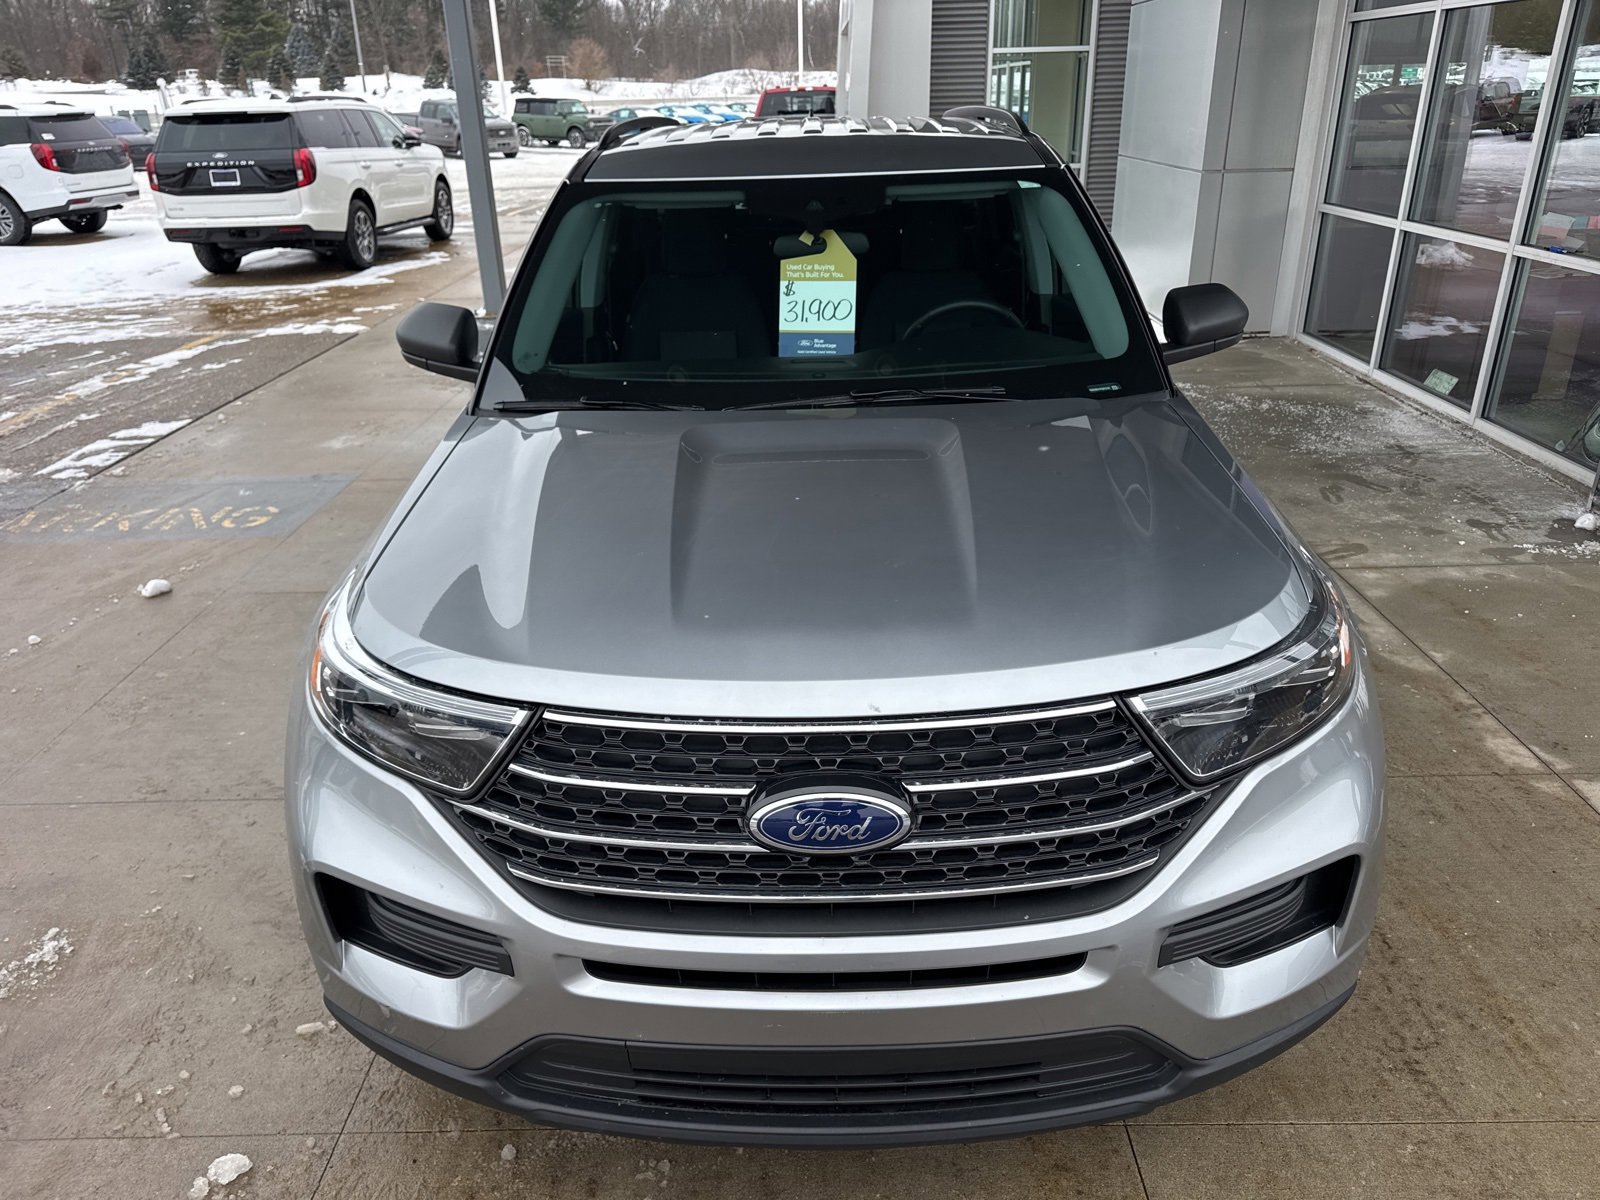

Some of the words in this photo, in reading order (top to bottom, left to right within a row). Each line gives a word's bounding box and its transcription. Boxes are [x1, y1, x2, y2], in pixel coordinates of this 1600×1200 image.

[186, 160, 255, 168] EXPEDITION
[813, 263, 835, 271] Buying
[783, 280, 796, 296] $
[784, 298, 853, 323] 31,900
[788, 808, 873, 841] Ford
